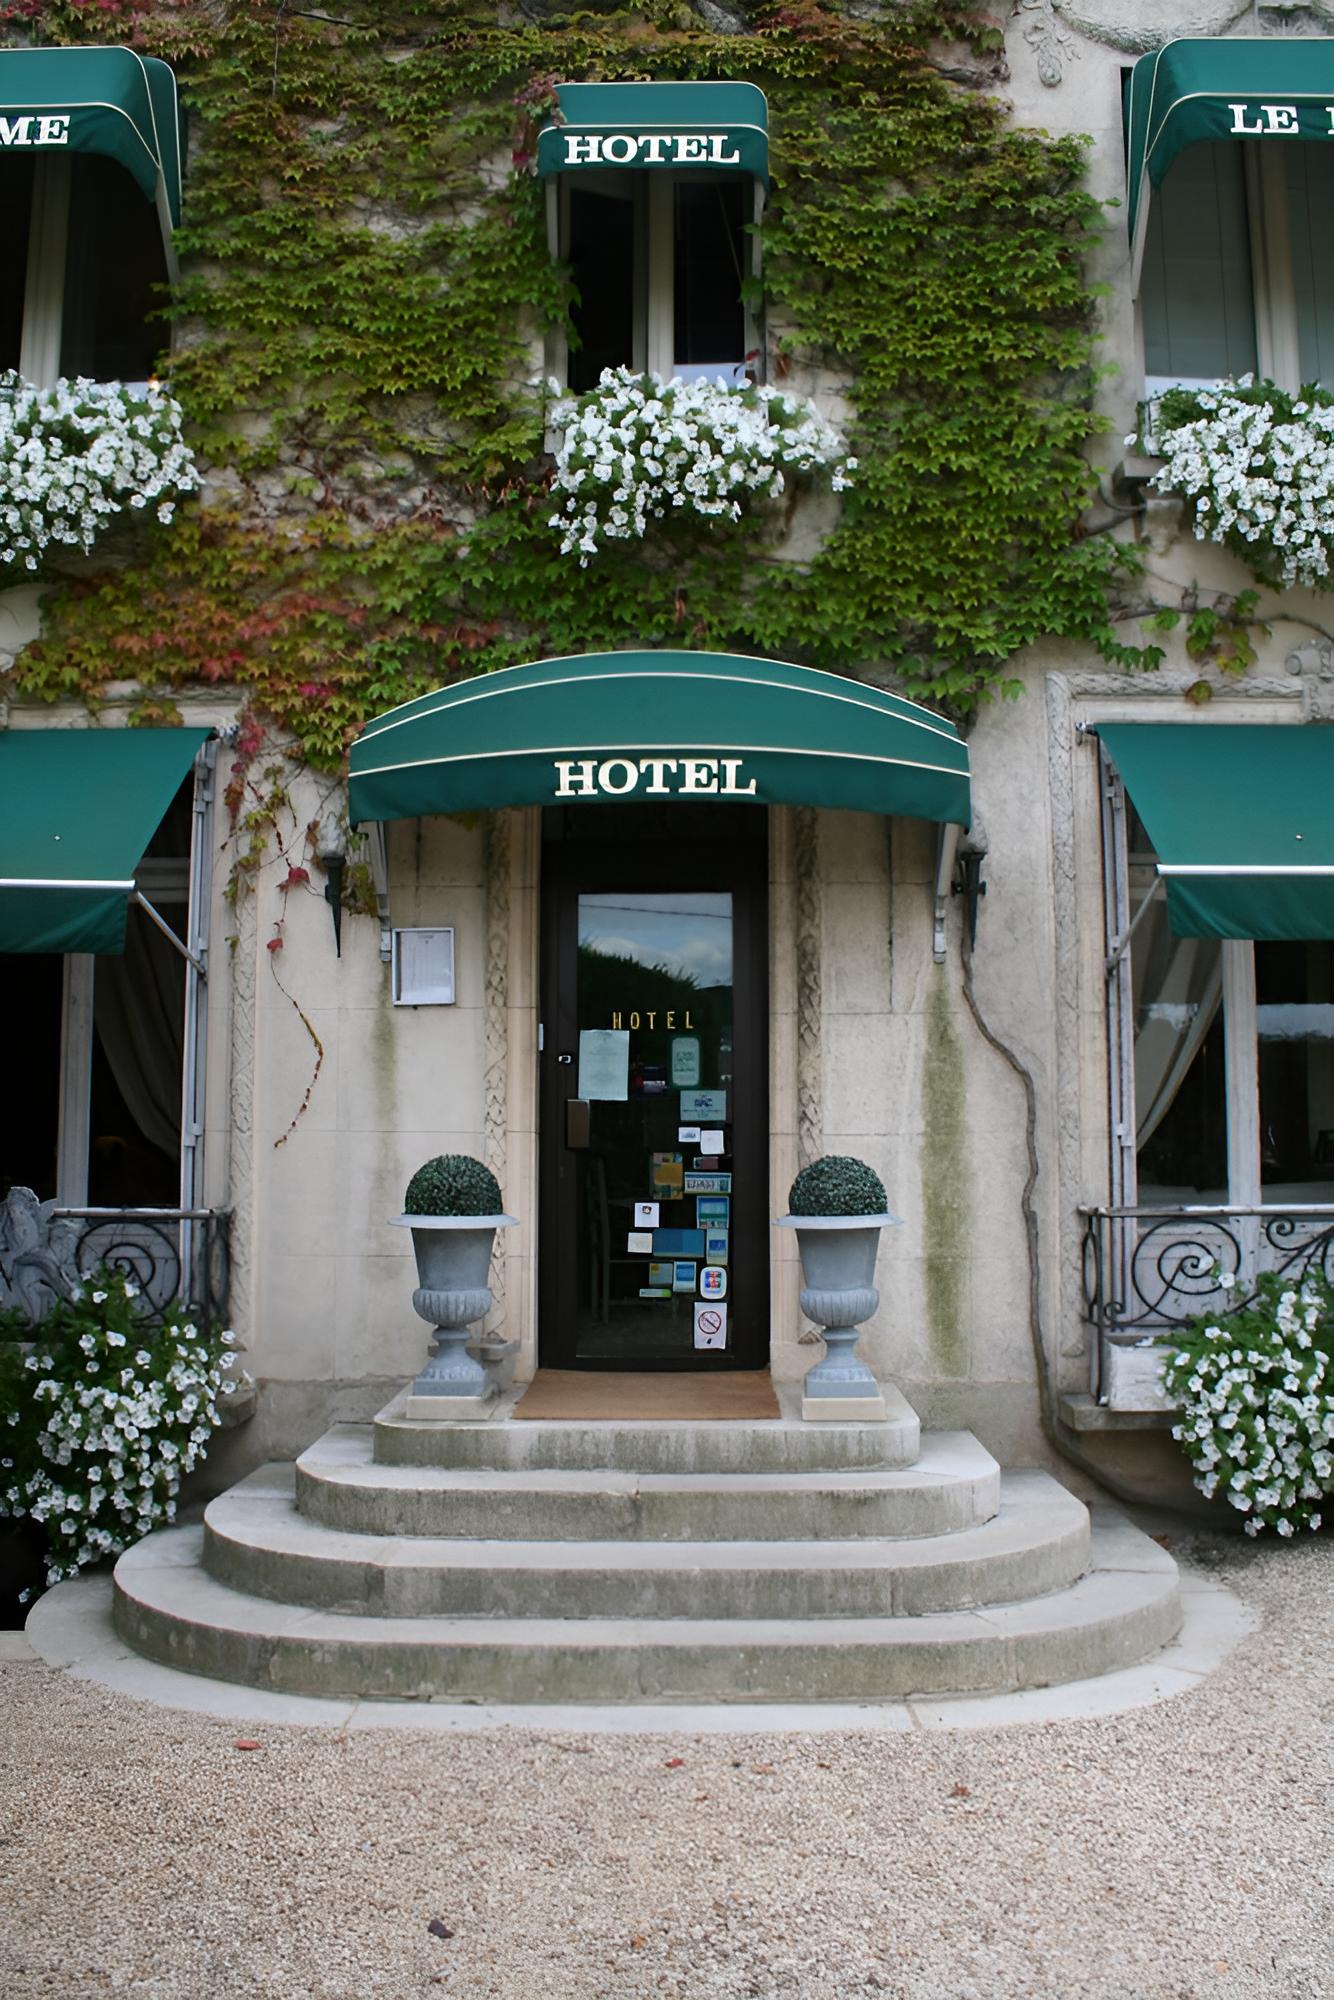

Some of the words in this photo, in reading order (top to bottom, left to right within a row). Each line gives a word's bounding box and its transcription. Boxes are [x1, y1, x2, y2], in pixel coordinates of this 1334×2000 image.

[0, 115, 71, 145] ME
[1227, 104, 1299, 134] LE
[564, 134, 740, 164] HOTEL
[554, 758, 757, 797] HOTEL
[612, 1010, 695, 1030] HOTEL
